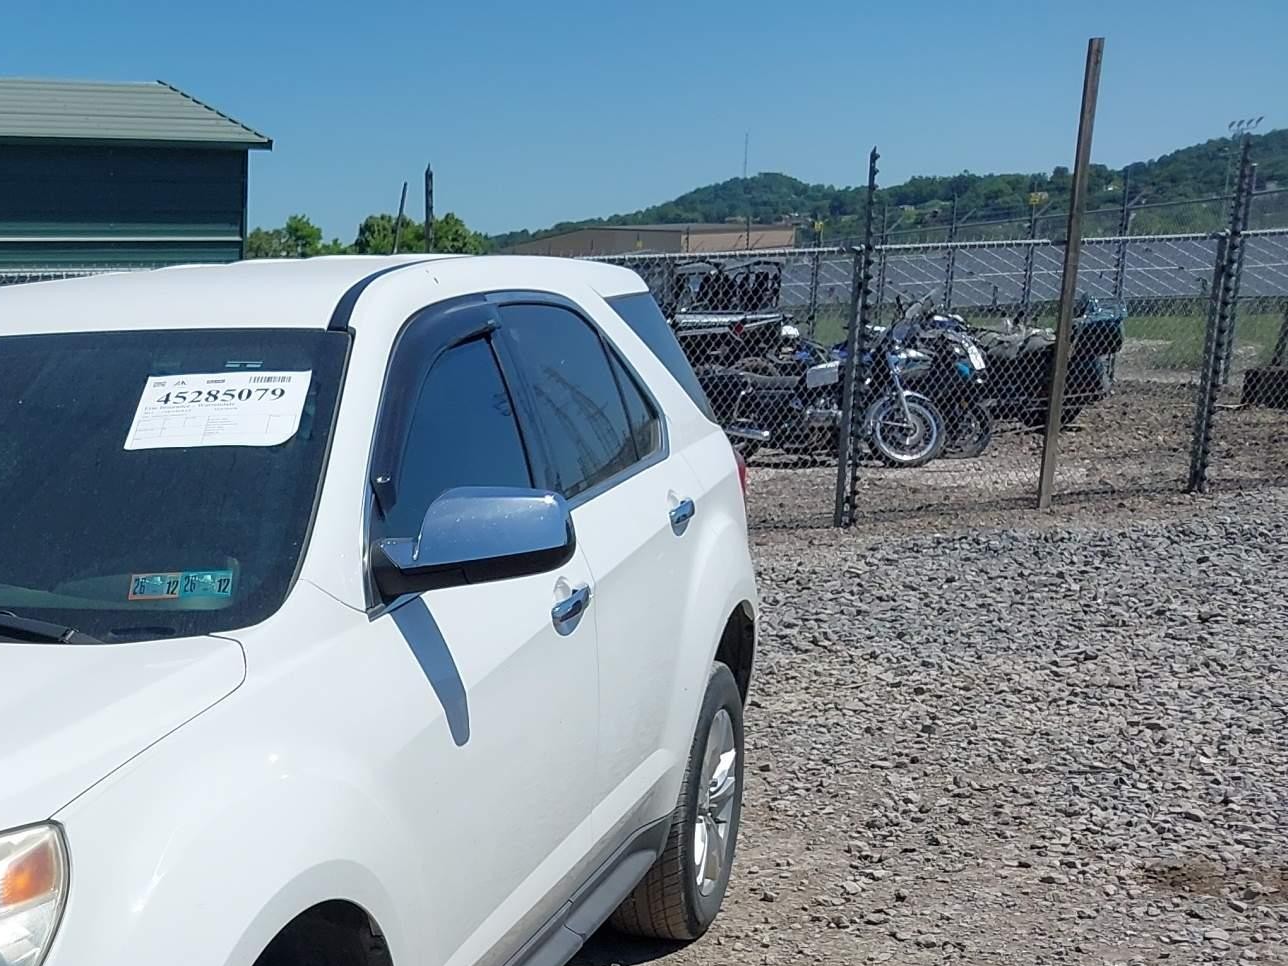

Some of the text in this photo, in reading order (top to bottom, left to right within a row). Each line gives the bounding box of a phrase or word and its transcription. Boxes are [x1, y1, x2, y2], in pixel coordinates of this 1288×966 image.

[156, 387, 286, 405] 45285079
[133, 577, 179, 595] 26 12
[184, 575, 230, 594] 26 12
